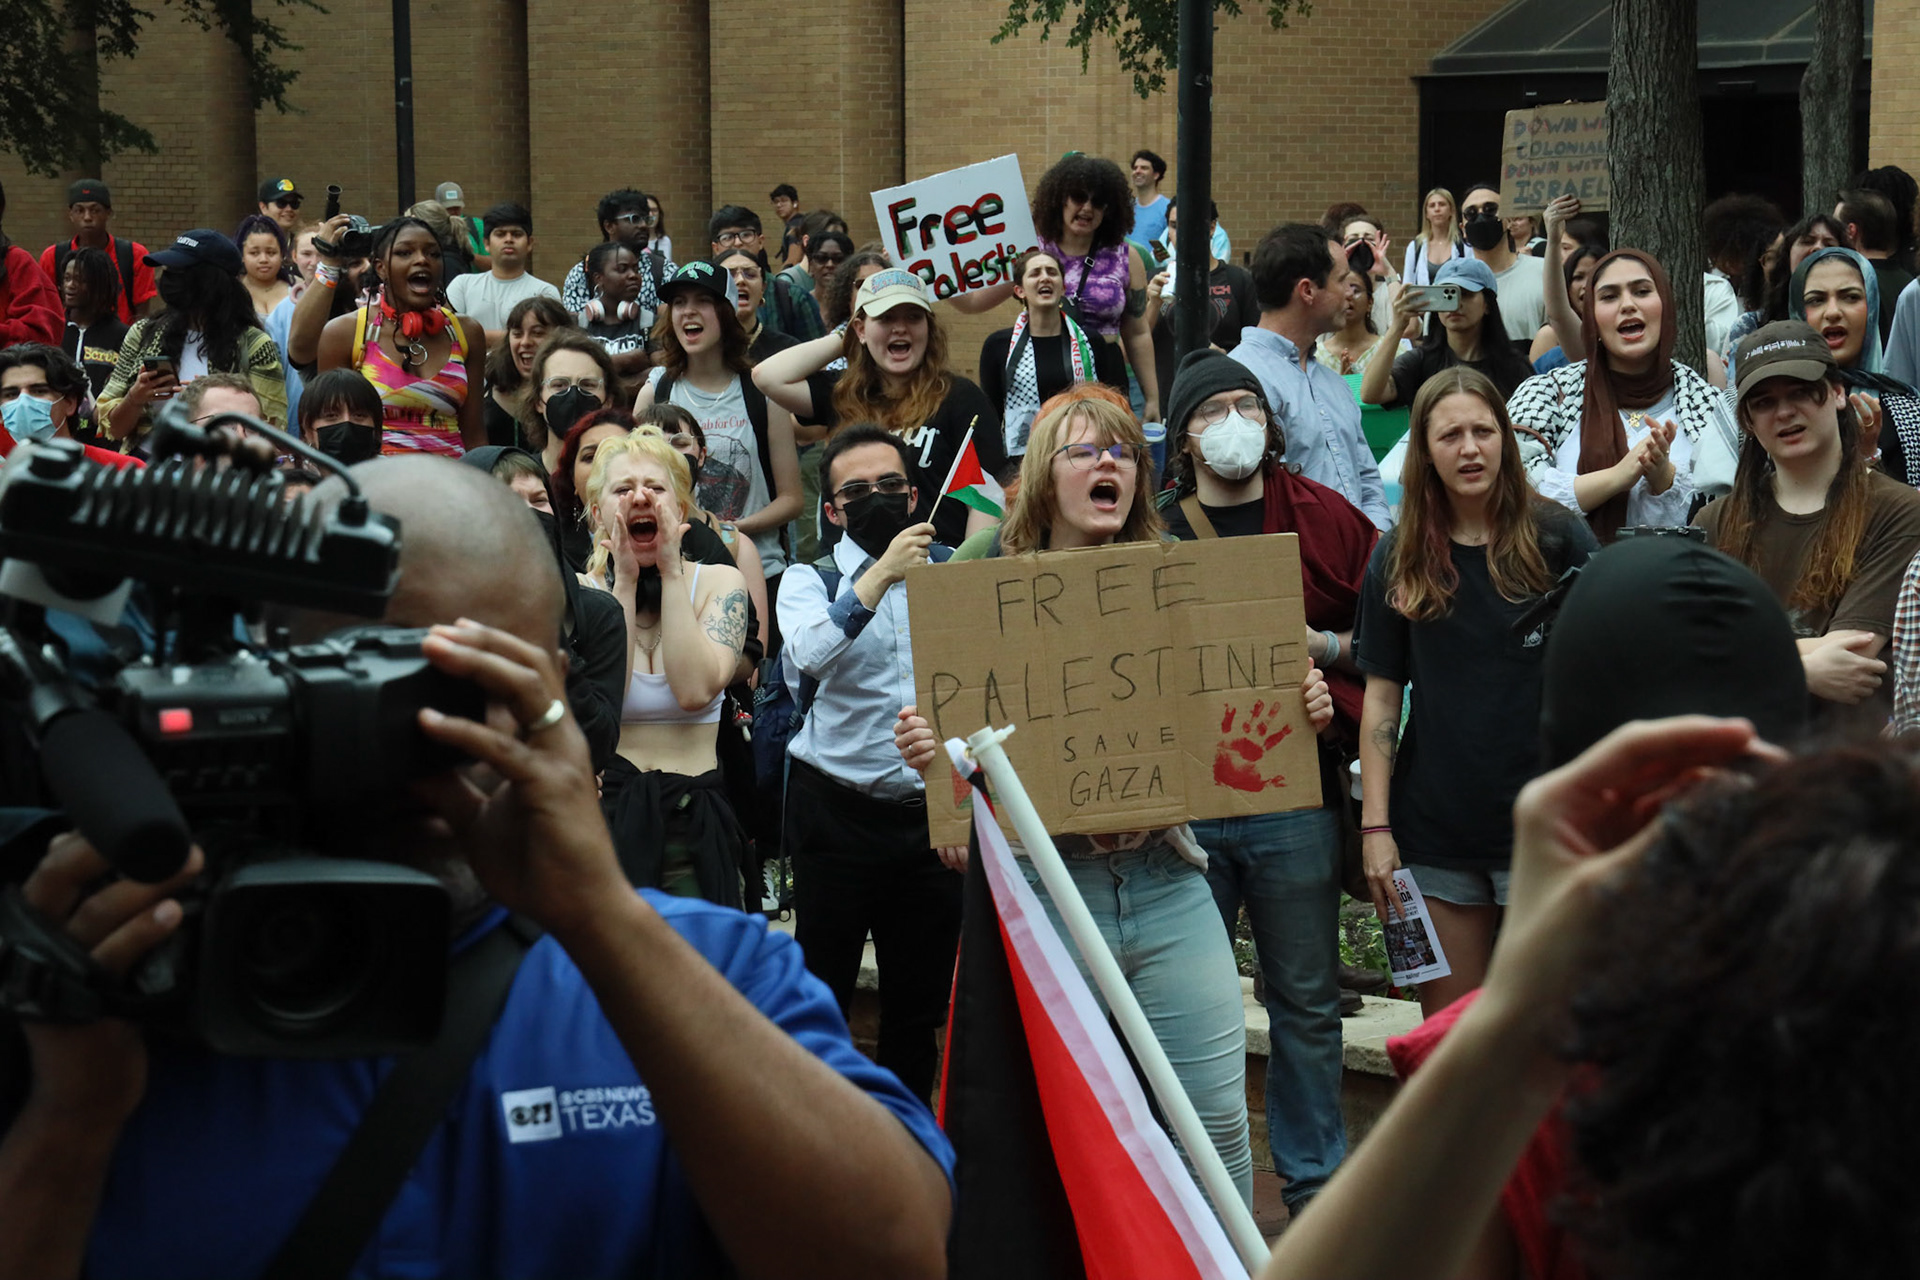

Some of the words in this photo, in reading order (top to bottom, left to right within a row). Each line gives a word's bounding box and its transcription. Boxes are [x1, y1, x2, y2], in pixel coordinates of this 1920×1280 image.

[1513, 115, 1578, 140] DOWN
[1582, 115, 1608, 132] WI
[1516, 140, 1607, 160] COLONIAL
[1505, 160, 1559, 180] DOWN
[1513, 177, 1609, 204] ISRAEL
[888, 193, 1006, 260] Free
[907, 242, 1039, 300] Palesti
[995, 561, 1205, 637] FREE
[931, 641, 1303, 741] PALESTINE
[1063, 726, 1176, 763] SAVE
[1070, 765, 1165, 807] GAZA
[560, 1099, 657, 1131] TEXAS
